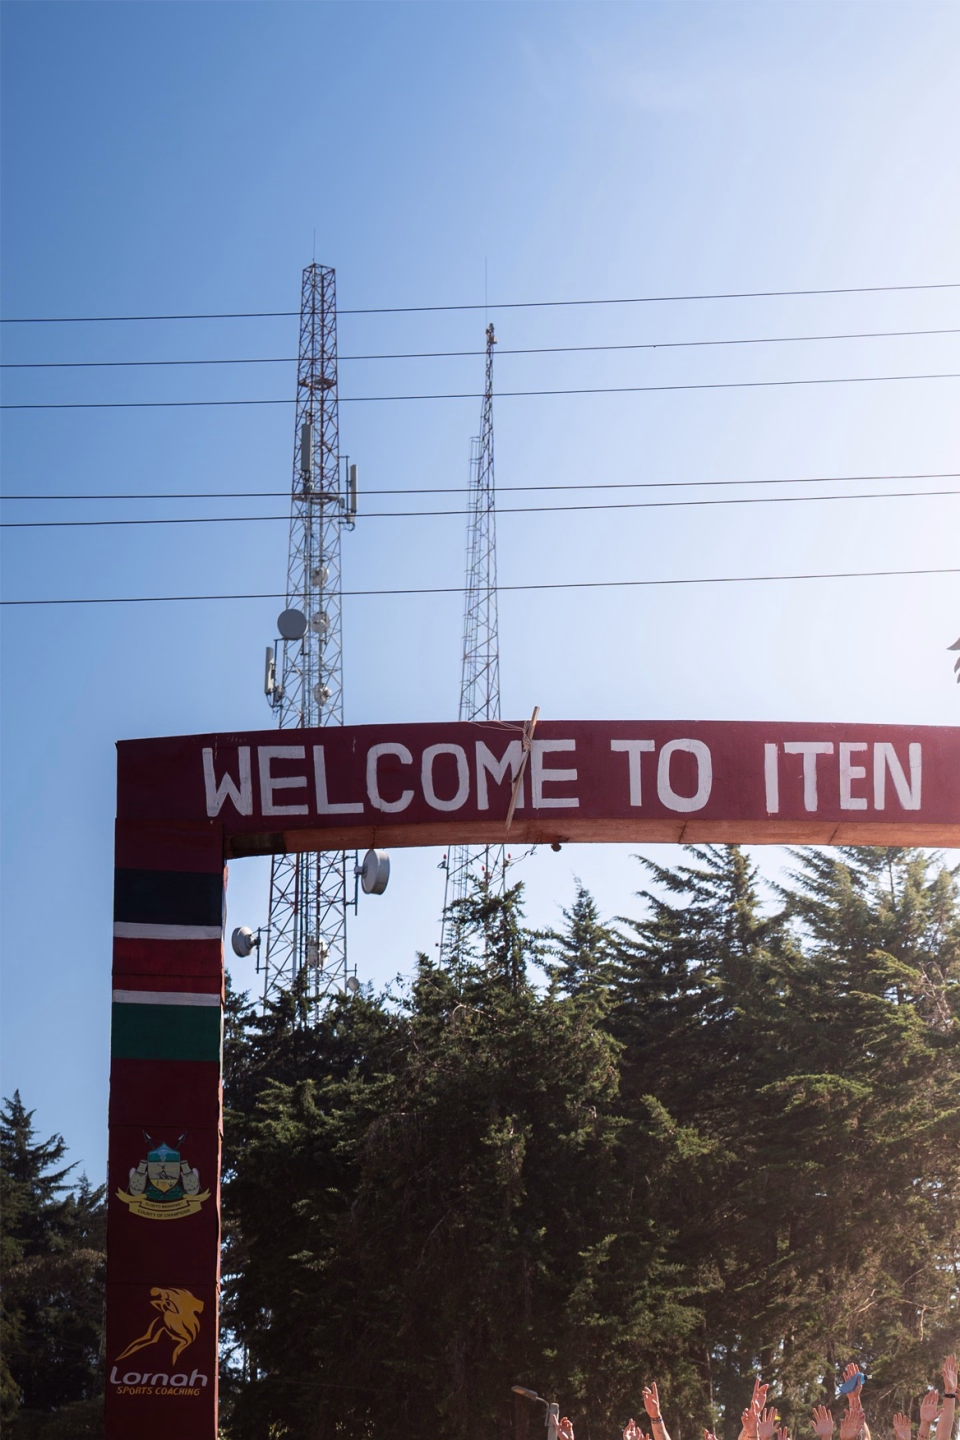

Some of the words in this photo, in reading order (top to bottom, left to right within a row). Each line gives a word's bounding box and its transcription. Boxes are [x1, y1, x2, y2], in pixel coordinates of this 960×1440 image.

[202, 739, 579, 818] WELCOME
[610, 738, 713, 813] TO
[764, 741, 923, 814] ITEN
[137, 1208, 156, 1218] COUNTY
[163, 1208, 191, 1218] CHAMPIONS
[109, 1365, 208, 1387] Lornah
[116, 1386, 153, 1395] SPORTS
[154, 1387, 200, 1396] COACHING
